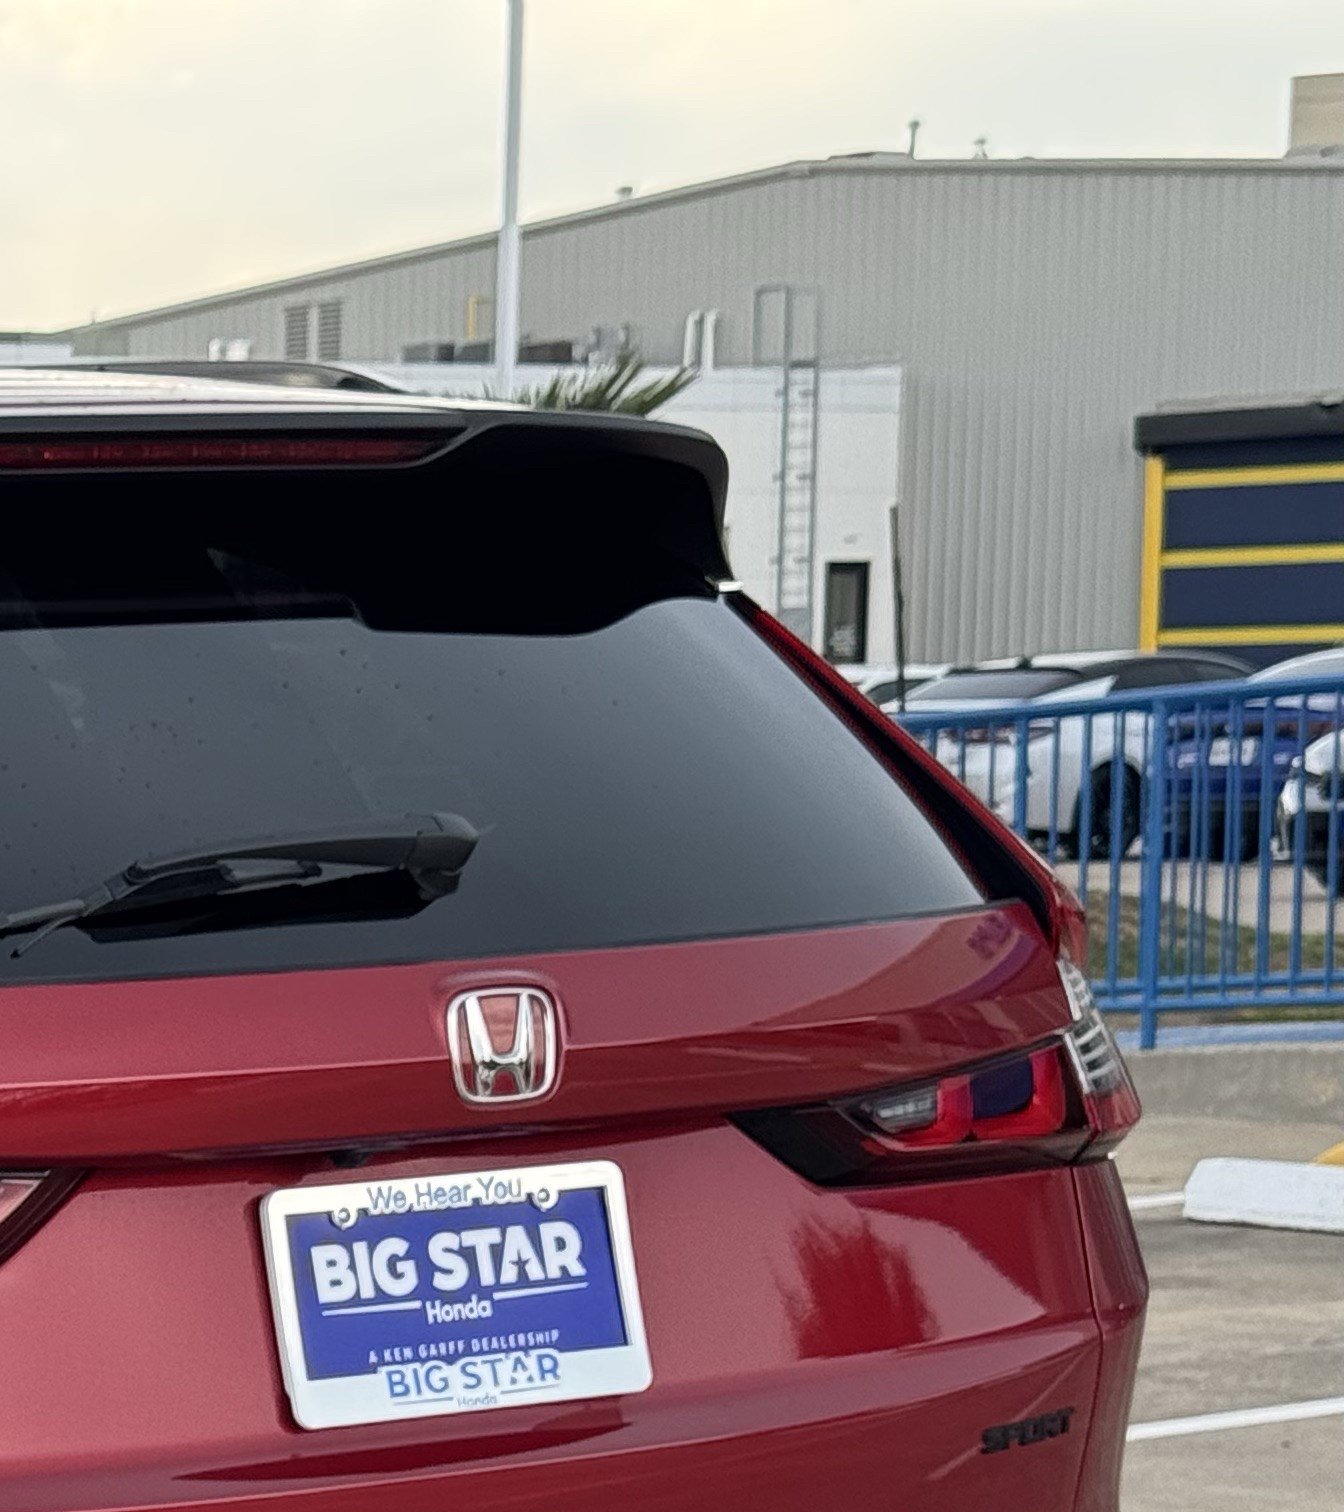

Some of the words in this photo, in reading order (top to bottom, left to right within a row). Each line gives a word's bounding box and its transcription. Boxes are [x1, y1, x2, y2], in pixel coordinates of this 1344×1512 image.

[366, 1185, 407, 1209] We
[414, 1181, 472, 1207] Hear
[476, 1176, 522, 1201] You
[310, 1236, 419, 1304] BIG
[428, 1220, 588, 1292] STAR
[425, 1294, 494, 1325] Honda
[383, 1346, 415, 1363] KEN
[418, 1339, 466, 1359] GARFF
[471, 1329, 560, 1353] DEALERSHIP
[385, 1364, 450, 1399] BIG
[460, 1352, 562, 1390] STAR
